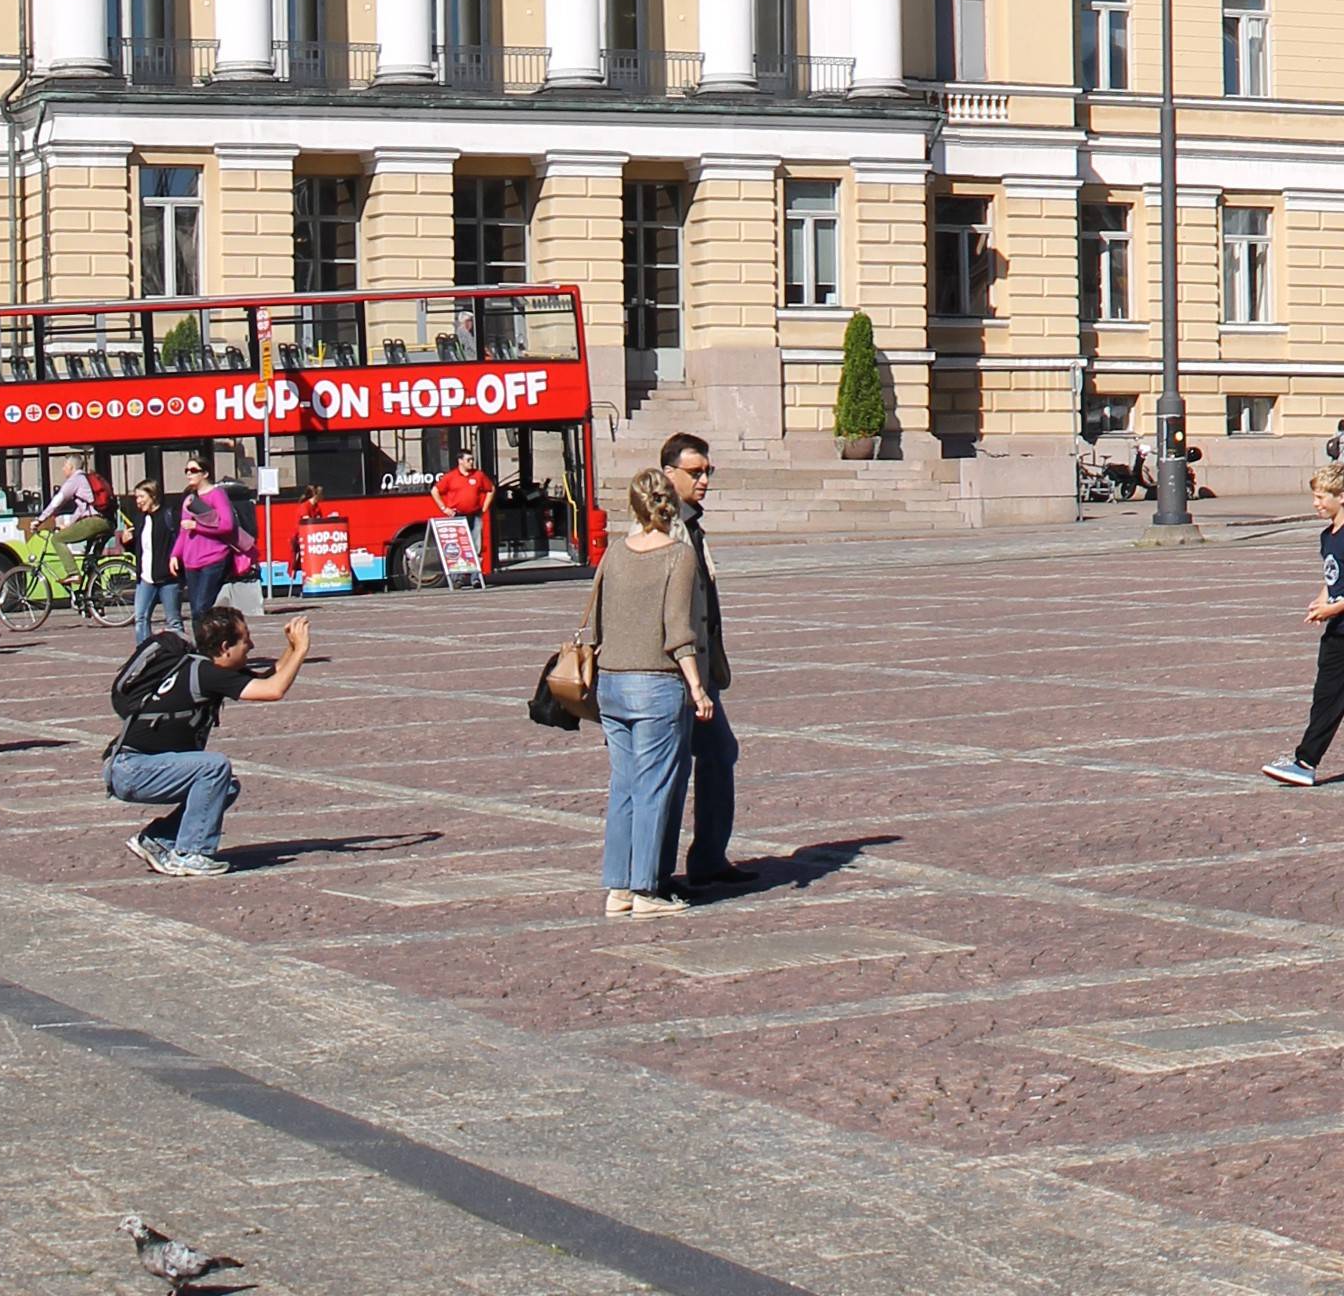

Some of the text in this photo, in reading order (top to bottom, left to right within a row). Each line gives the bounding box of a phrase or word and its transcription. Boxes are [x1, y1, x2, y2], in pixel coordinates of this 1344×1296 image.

[215, 370, 548, 420] HOP-ON HOP-OFF
[395, 473, 434, 485] AUDIO
[307, 530, 348, 544] HOP-ON
[308, 542, 348, 554] HOP-OFF
